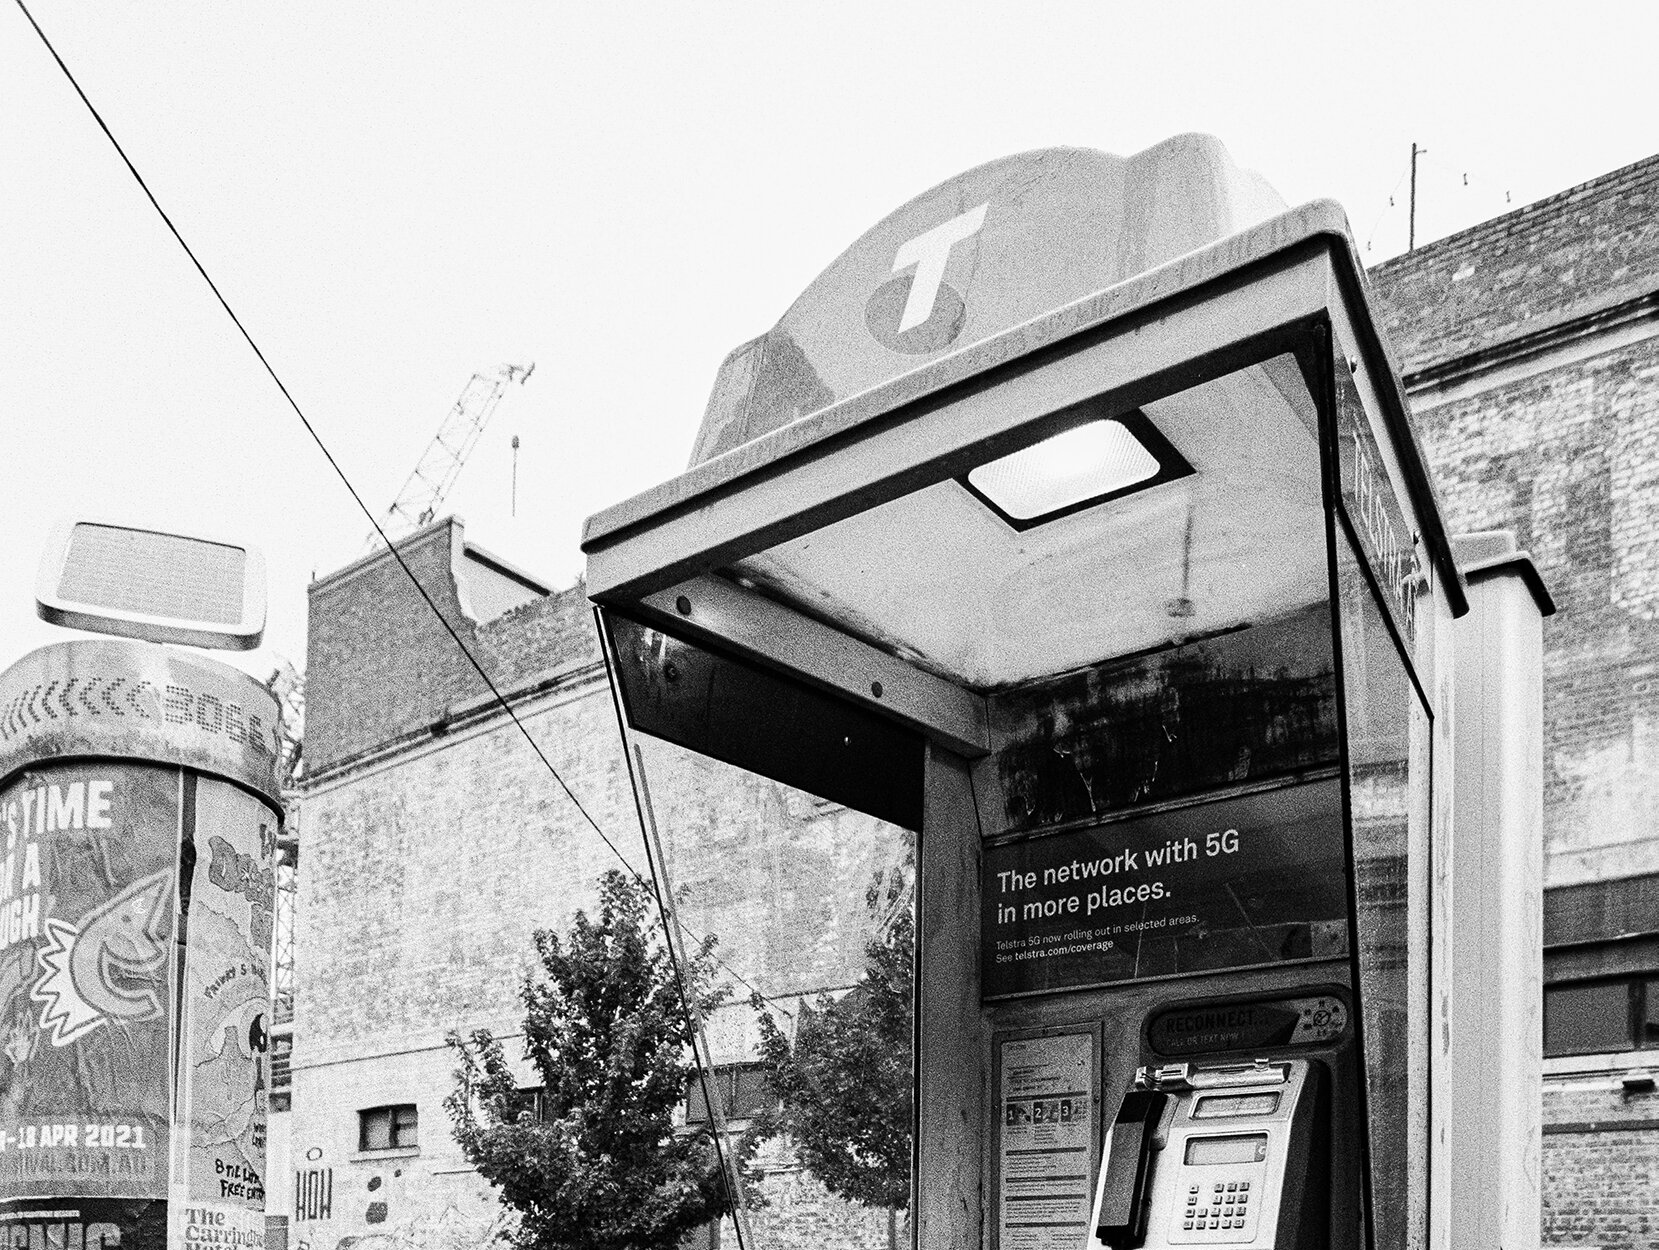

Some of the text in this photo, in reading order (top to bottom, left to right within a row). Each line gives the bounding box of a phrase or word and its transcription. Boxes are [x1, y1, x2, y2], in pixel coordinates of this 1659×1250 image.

[892, 202, 989, 333] T
[22, 780, 114, 839] TIME
[997, 829, 1240, 893] The network with 5G
[997, 881, 1172, 924] in more places.
[996, 914, 1200, 950] Telstra 5G now rolling out in selected areas.
[995, 939, 1114, 964] See telstra.com/coverage
[1034, 1108, 1042, 1119] 2
[1062, 1105, 1069, 1117] 3
[39, 1124, 78, 1148] APR
[85, 1124, 146, 1149] 2021
[226, 1165, 241, 1178] TIL
[220, 1179, 246, 1197] FREE
[184, 1208, 225, 1226] The
